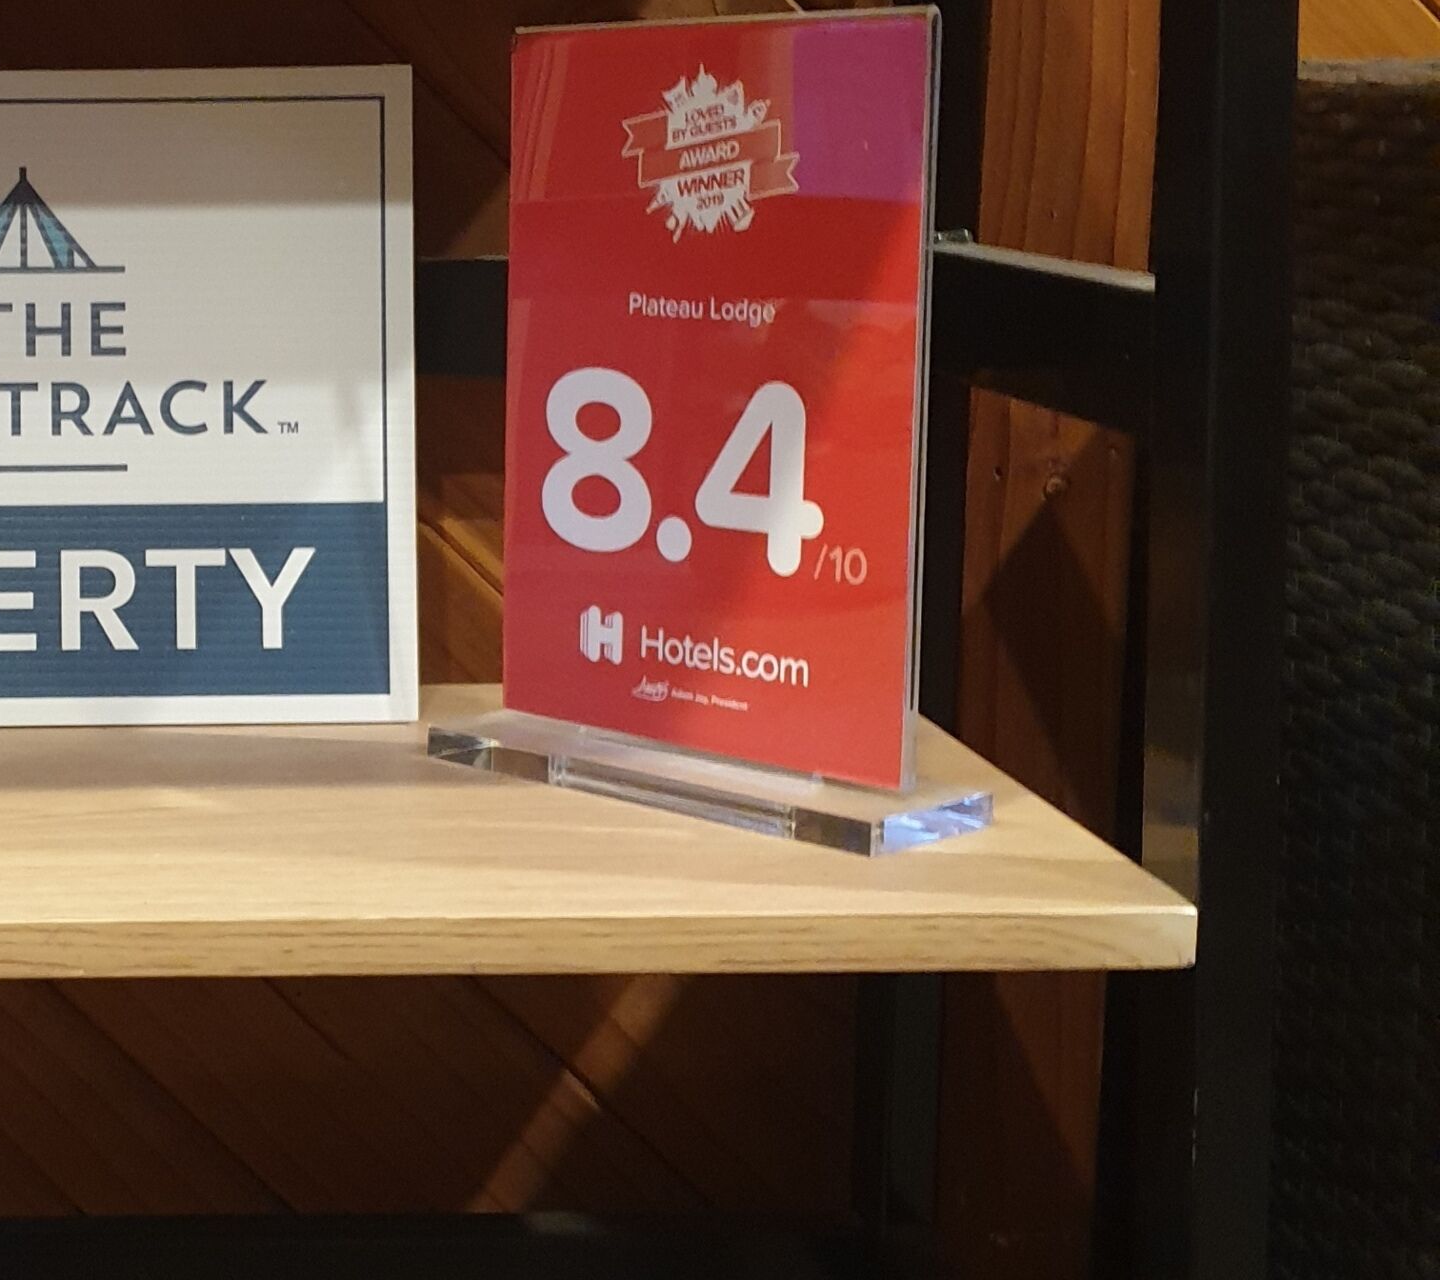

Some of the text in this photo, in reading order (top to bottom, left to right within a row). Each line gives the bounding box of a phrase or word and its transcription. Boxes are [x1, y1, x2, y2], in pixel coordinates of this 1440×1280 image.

[672, 127, 687, 143] BY
[679, 140, 740, 170] AWARD
[677, 168, 745, 197] WINNER
[629, 291, 777, 328] Plateau Lodge
[640, 624, 810, 688] Hotels.com
